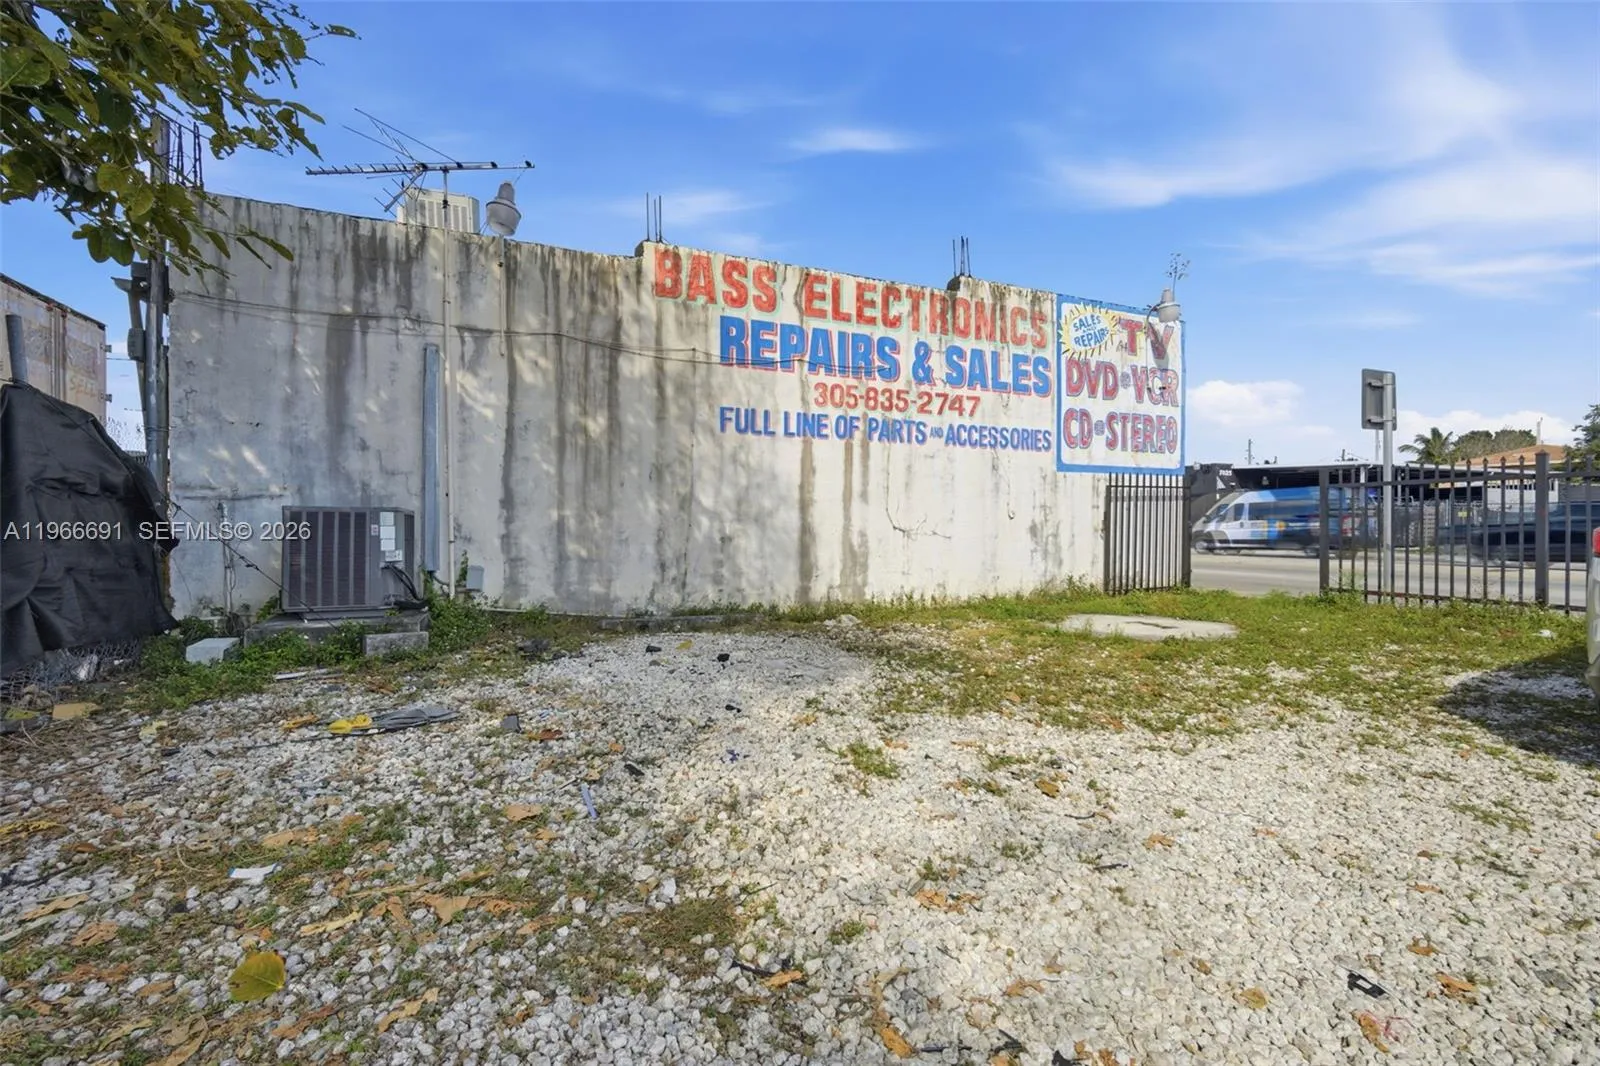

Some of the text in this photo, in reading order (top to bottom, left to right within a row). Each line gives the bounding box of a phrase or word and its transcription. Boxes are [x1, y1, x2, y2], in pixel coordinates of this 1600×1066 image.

[655, 246, 1049, 349] BASS ELECTRONICS
[1073, 314, 1102, 333] SALES
[1119, 318, 1175, 360] TV
[719, 314, 1052, 398] REPAIRS & SALES
[814, 381, 981, 418] 305-835-2747
[1065, 357, 1119, 401] DVD
[719, 405, 1052, 452] FULL LINE OF PARTS AND ACCESSORIES
[1062, 407, 1179, 455] CD STEREO
